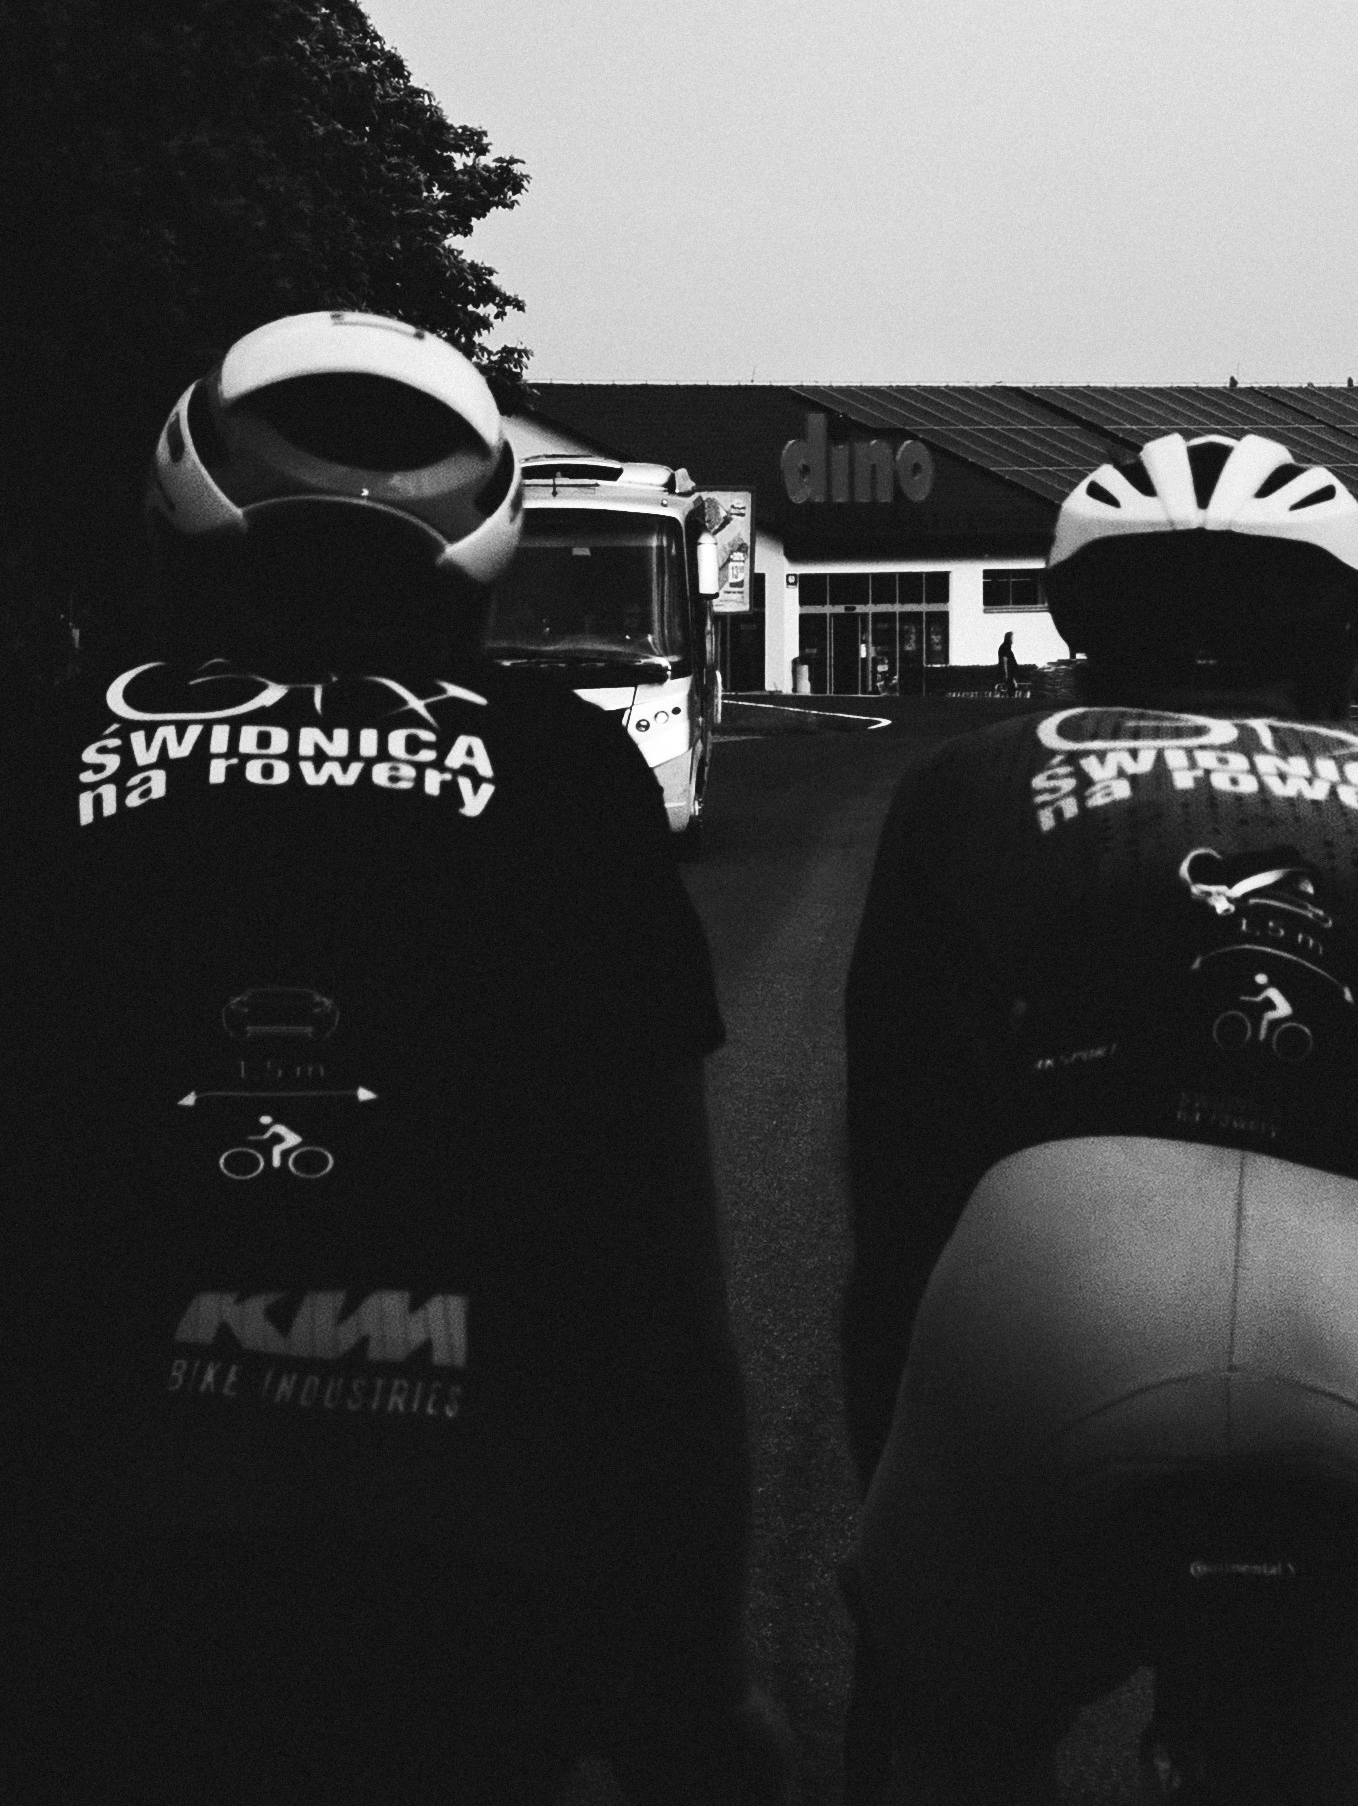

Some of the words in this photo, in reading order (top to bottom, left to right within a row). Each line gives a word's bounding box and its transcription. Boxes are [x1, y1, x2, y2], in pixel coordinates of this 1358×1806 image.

[781, 413, 934, 504] dino
[78, 723, 495, 784] ŚWIDNICA
[79, 767, 168, 826] na
[208, 757, 496, 818] rowery
[1036, 777, 1133, 834] na
[1297, 932, 1324, 955] m
[295, 1062, 326, 1079] m
[174, 1290, 470, 1368] KTM
[168, 1358, 240, 1397] BIKE
[263, 1369, 463, 1418] INDUSTRIES
